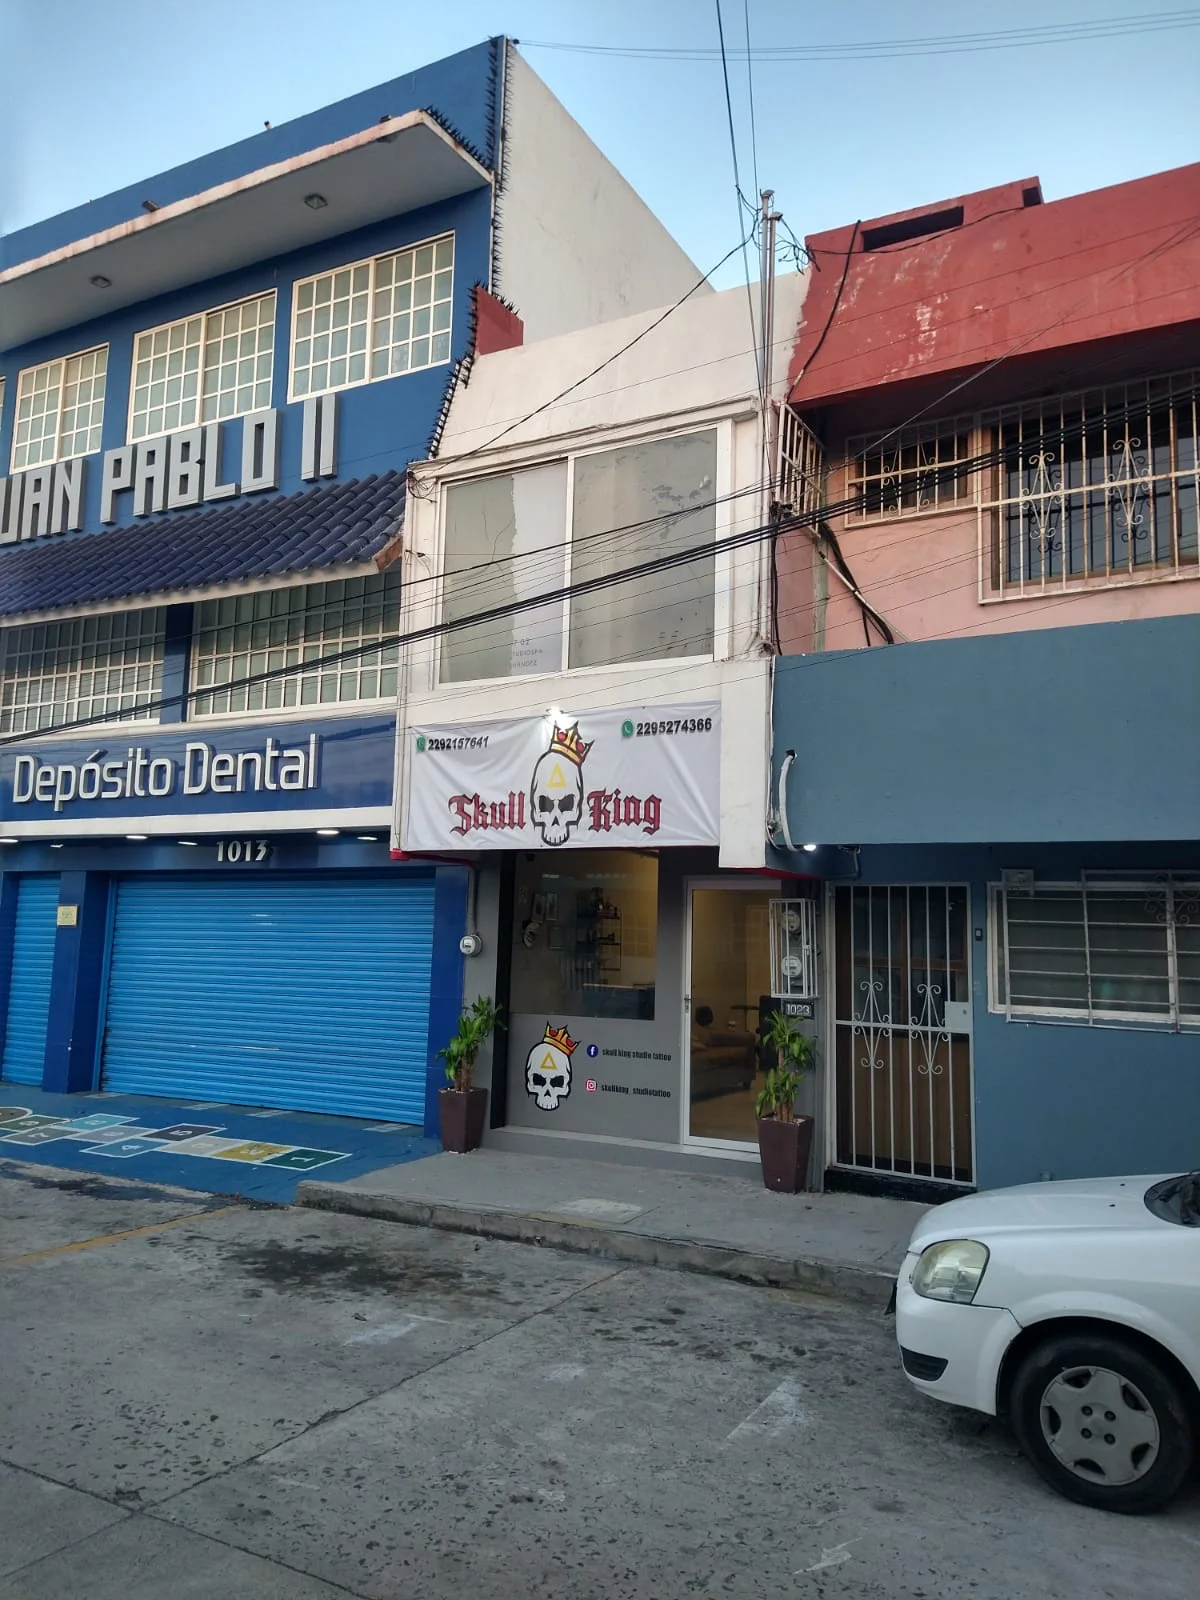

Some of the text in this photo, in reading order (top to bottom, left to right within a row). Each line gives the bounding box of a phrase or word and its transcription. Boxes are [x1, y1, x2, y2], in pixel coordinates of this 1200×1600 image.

[100, 407, 279, 523] PABLO
[301, 393, 337, 481] II
[636, 717, 713, 737] 2295274366
[428, 736, 489, 751] 2292157641
[13, 733, 318, 812] Depósito Dental
[448, 787, 662, 837] Skull King
[217, 840, 268, 862] 1013
[786, 1003, 811, 1015] 1023
